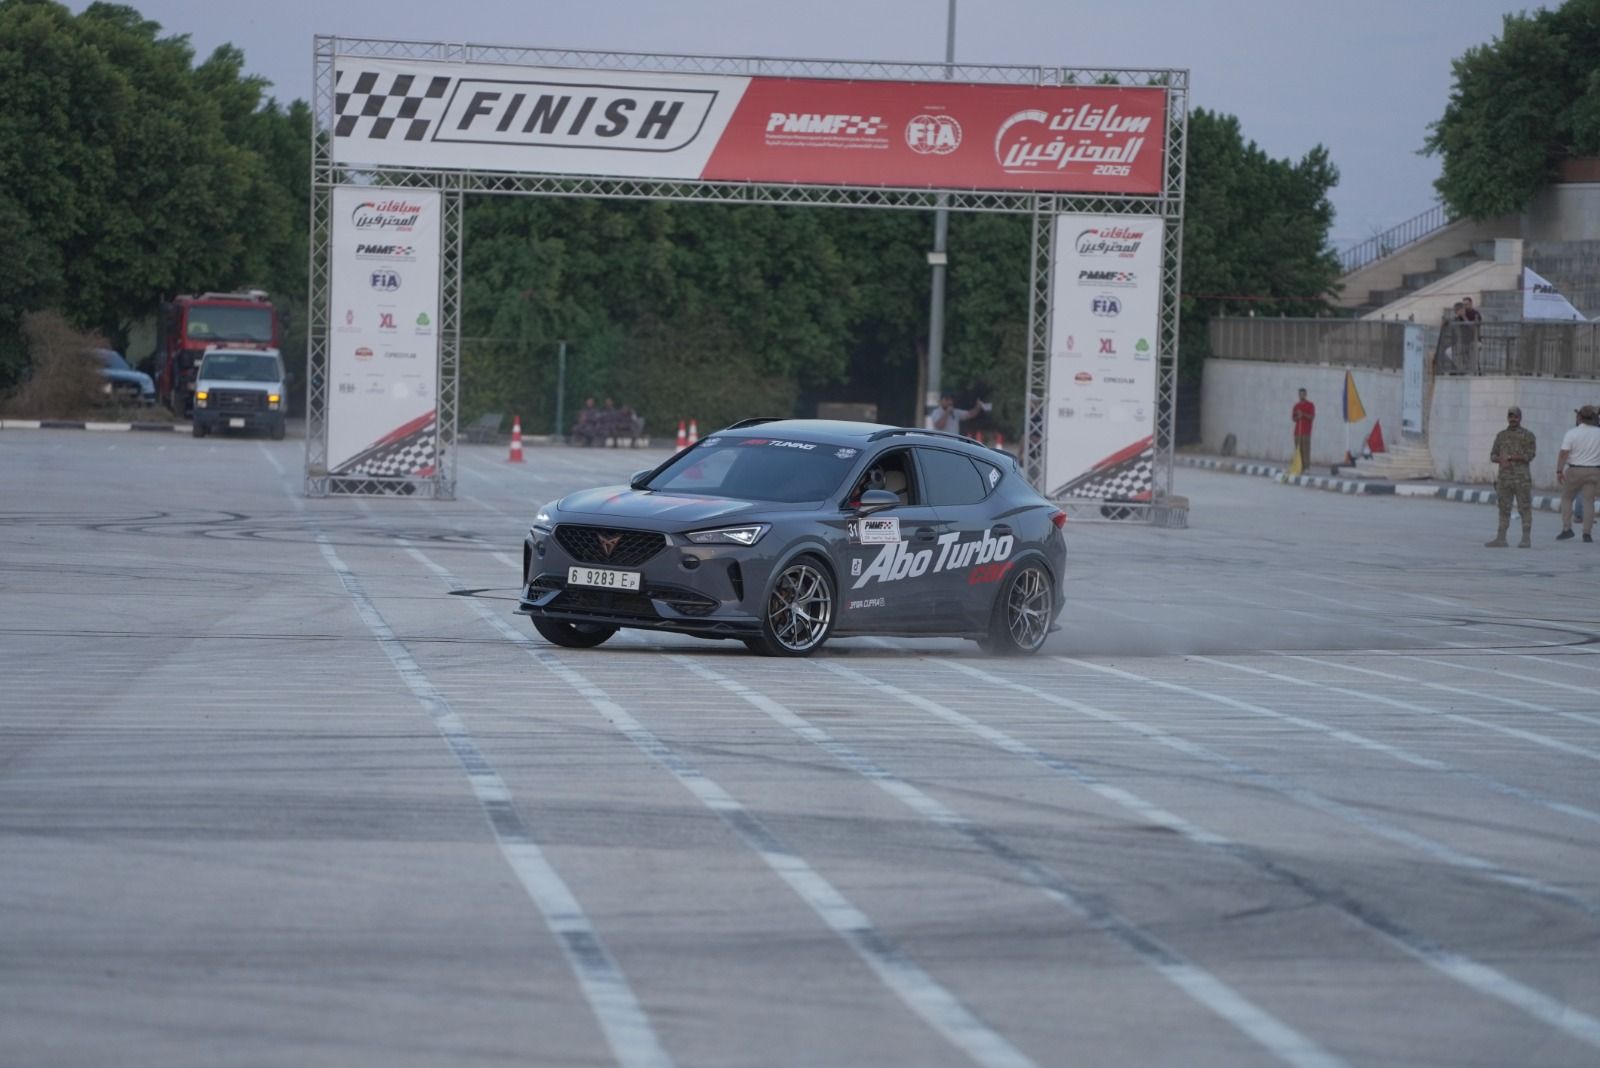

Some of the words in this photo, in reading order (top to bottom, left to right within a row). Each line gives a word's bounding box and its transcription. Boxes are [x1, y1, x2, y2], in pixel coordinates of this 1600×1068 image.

[457, 91, 684, 140] FINISH
[766, 112, 846, 134] PMMF
[1049, 103, 1151, 138] سباقات
[1003, 136, 1144, 170] المحترفين
[1093, 165, 1131, 176] 2026
[376, 200, 421, 215] سباقات
[356, 213, 419, 228] المحترفين
[1100, 227, 1144, 241] سباقات
[356, 244, 396, 255] PMMF
[1080, 240, 1141, 254] المحترفين
[1078, 270, 1118, 281] PMMF
[379, 313, 397, 329] XL
[1099, 337, 1117, 354] XL
[769, 440, 817, 450] TUNING
[848, 523, 858, 538] 31
[865, 521, 885, 530] PMMF
[851, 540, 933, 590] Abo
[933, 529, 1014, 573] Turbo
[571, 569, 578, 583] 6
[587, 570, 615, 586] 9283
